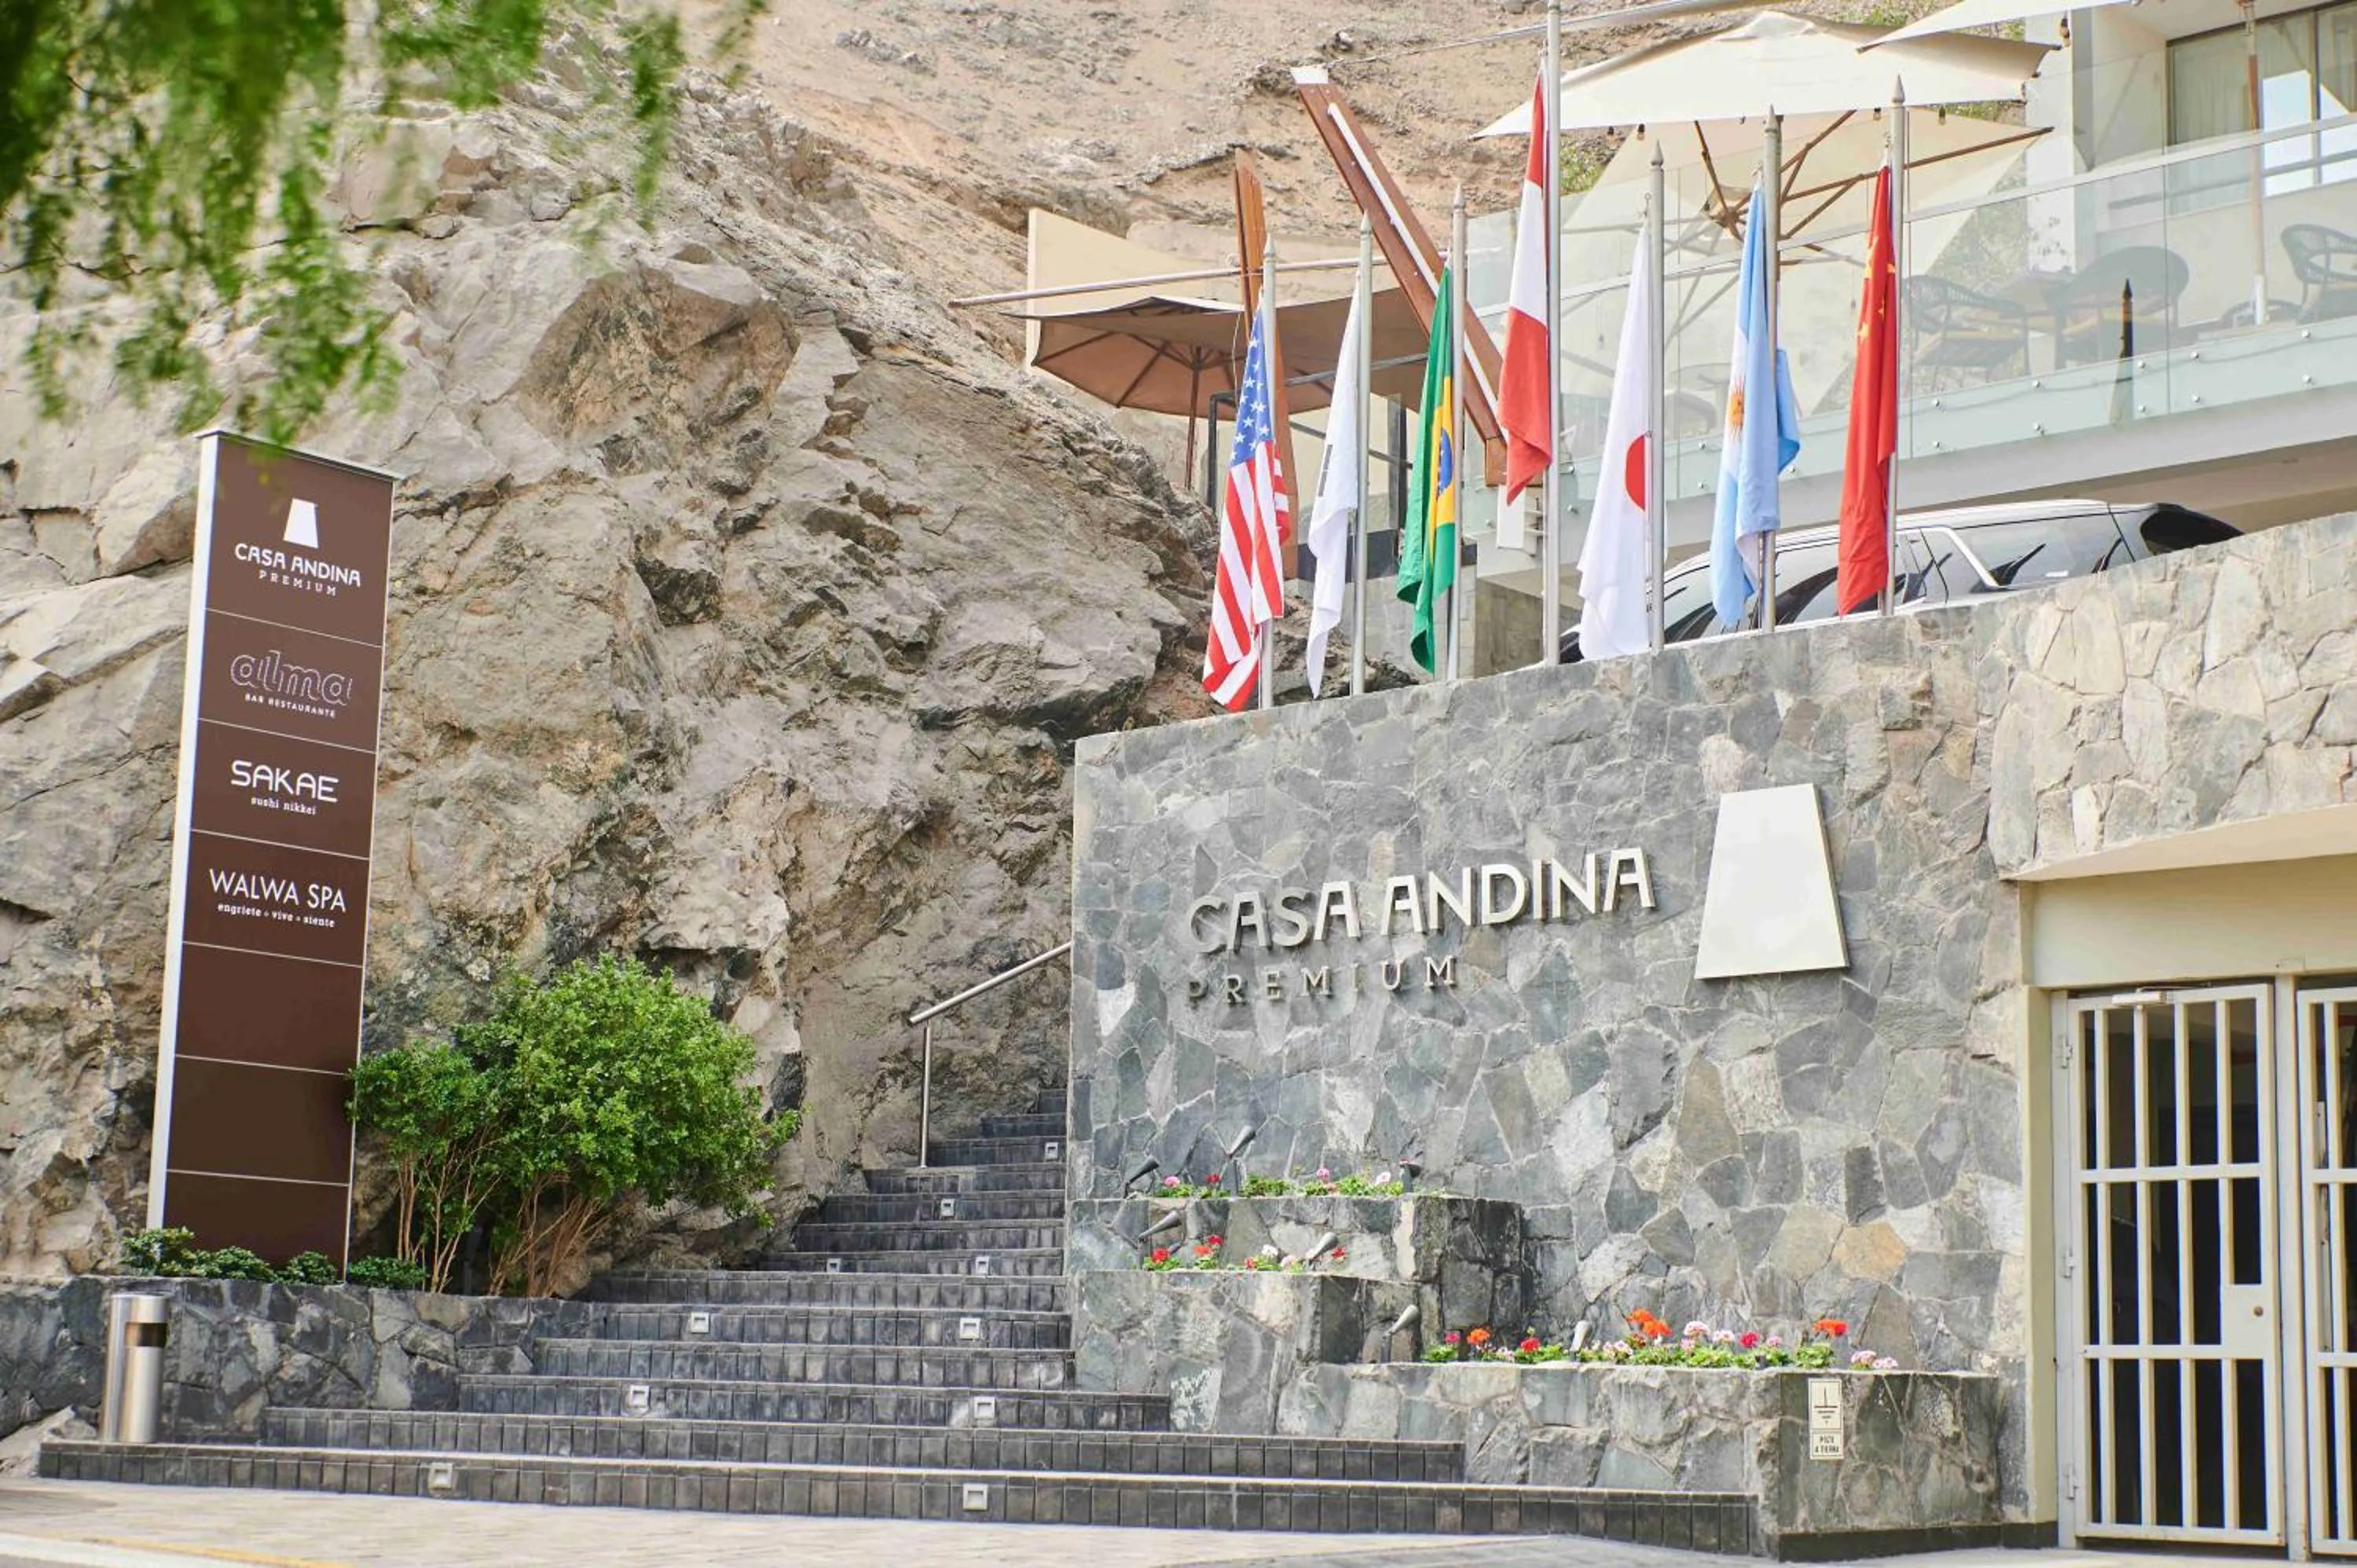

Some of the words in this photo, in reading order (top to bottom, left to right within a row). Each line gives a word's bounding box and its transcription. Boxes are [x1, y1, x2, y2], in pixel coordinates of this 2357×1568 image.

[234, 543, 286, 570] CASA
[291, 555, 361, 588] ANDINA
[258, 570, 337, 596] PREMIUM
[230, 650, 353, 705] alma
[244, 692, 264, 705] BAR
[268, 698, 336, 719] RESTAURANTE
[230, 760, 339, 803] SAKAE
[251, 796, 280, 809] sushi
[283, 800, 317, 815] nikkei
[208, 867, 299, 906] WALWA
[307, 883, 346, 913] SPA
[1190, 880, 1362, 954] CASA
[1380, 847, 1655, 936] ANDINA
[218, 903, 262, 918] engriete
[272, 910, 293, 922] vive
[303, 916, 335, 929] siente
[1187, 954, 1460, 1009] PREMIUM
